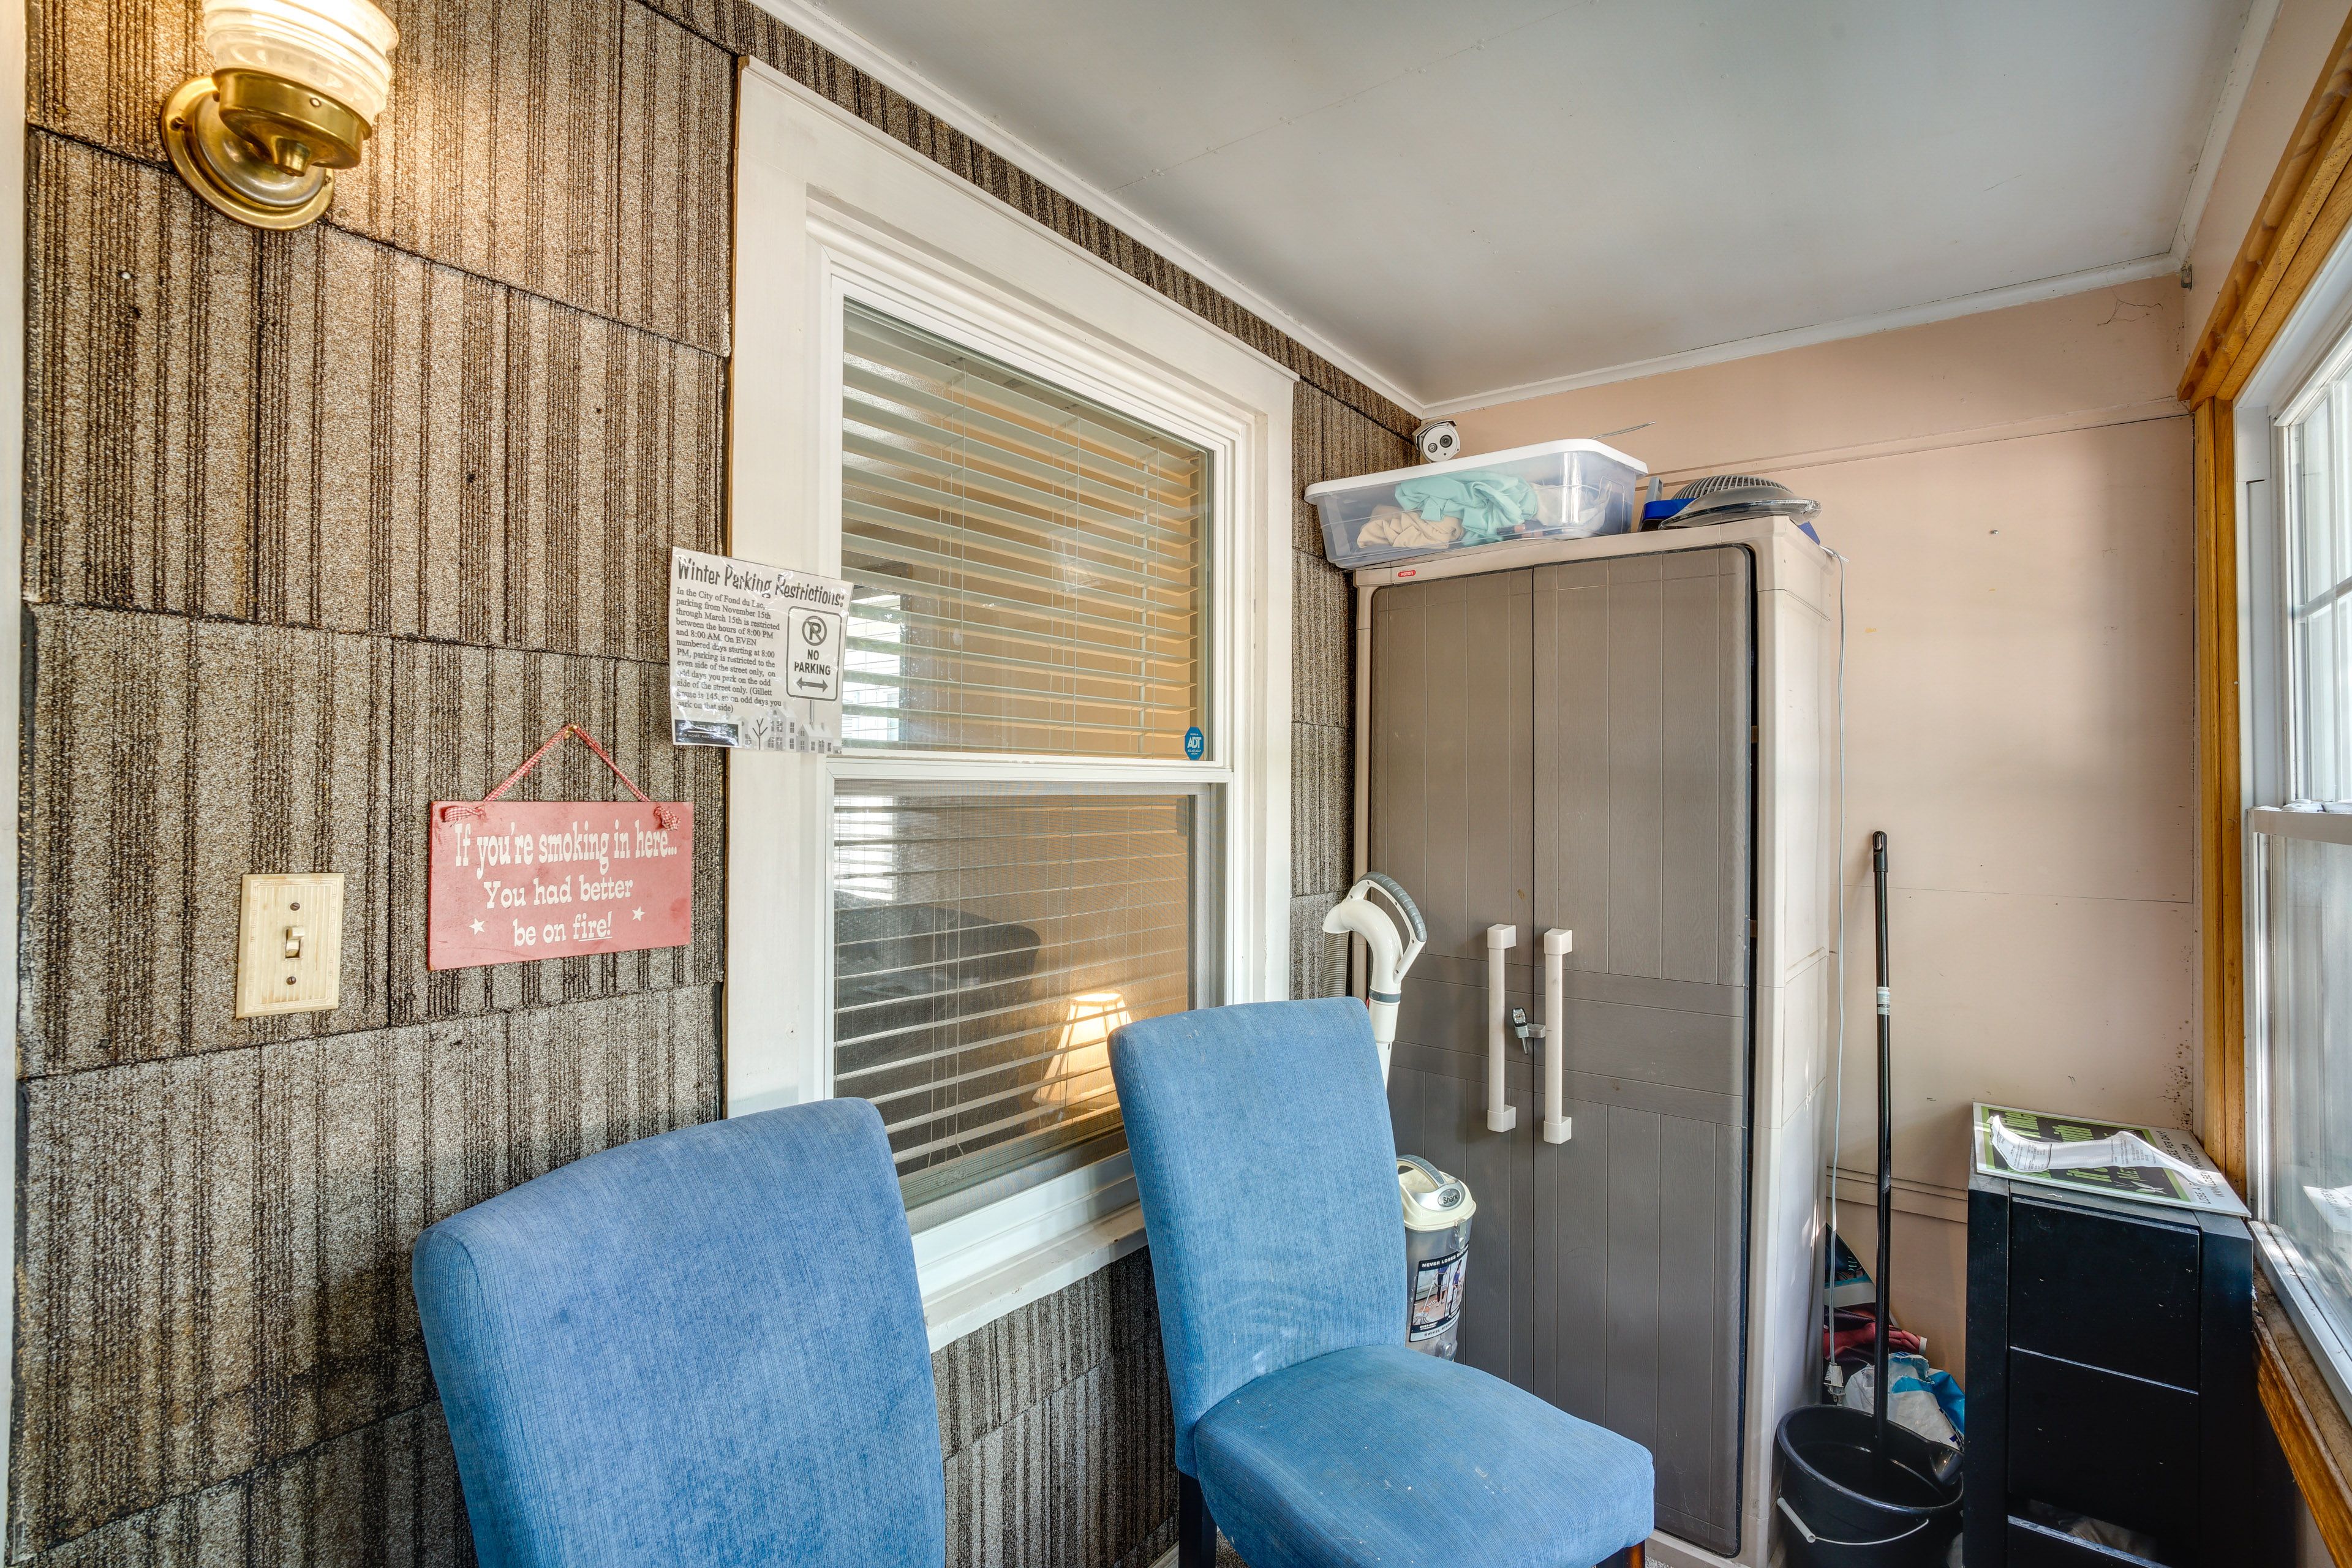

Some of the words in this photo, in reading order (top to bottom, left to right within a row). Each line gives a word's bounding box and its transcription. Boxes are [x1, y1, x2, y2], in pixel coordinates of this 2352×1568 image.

[678, 557, 720, 585] Winter
[725, 564, 772, 598] Parking
[775, 574, 845, 608] Restrictions:
[698, 590, 713, 601] City
[724, 595, 741, 605] Fond
[752, 600, 765, 610] Lac,
[676, 599, 703, 610] parking
[704, 602, 720, 611] from
[723, 605, 755, 617] November
[758, 611, 771, 619] 15th
[676, 608, 703, 619] through
[704, 612, 726, 622] March
[751, 621, 780, 630] restricted
[676, 617, 704, 628] between
[718, 624, 736, 633] hours
[736, 636, 757, 646] EVEN
[676, 640, 710, 649] numbered
[712, 643, 726, 652] days
[729, 647, 752, 657] starting
[807, 649, 819, 661] NO
[677, 648, 692, 658] PM,
[693, 652, 718, 662] parking
[727, 657, 756, 665] restricted
[692, 671, 707, 680] days
[749, 668, 764, 677] only,
[794, 662, 831, 676] PARKING
[732, 686, 748, 695] only.
[750, 687, 772, 696] (Gillett
[718, 704, 734, 714] side)
[754, 698, 769, 706] days
[1187, 736, 1202, 748] ADT
[455, 823, 471, 867] If
[477, 822, 533, 880] you're
[539, 821, 609, 875] smoking
[614, 820, 630, 859] in
[635, 820, 677, 858] here...
[483, 881, 526, 908] You
[533, 875, 572, 905] had
[579, 875, 633, 902] better
[513, 919, 537, 946] be
[543, 921, 566, 943] on
[573, 911, 612, 941] fire!
[1443, 1193, 1458, 1204] Shark
[1441, 1255, 1456, 1264] LOSES
